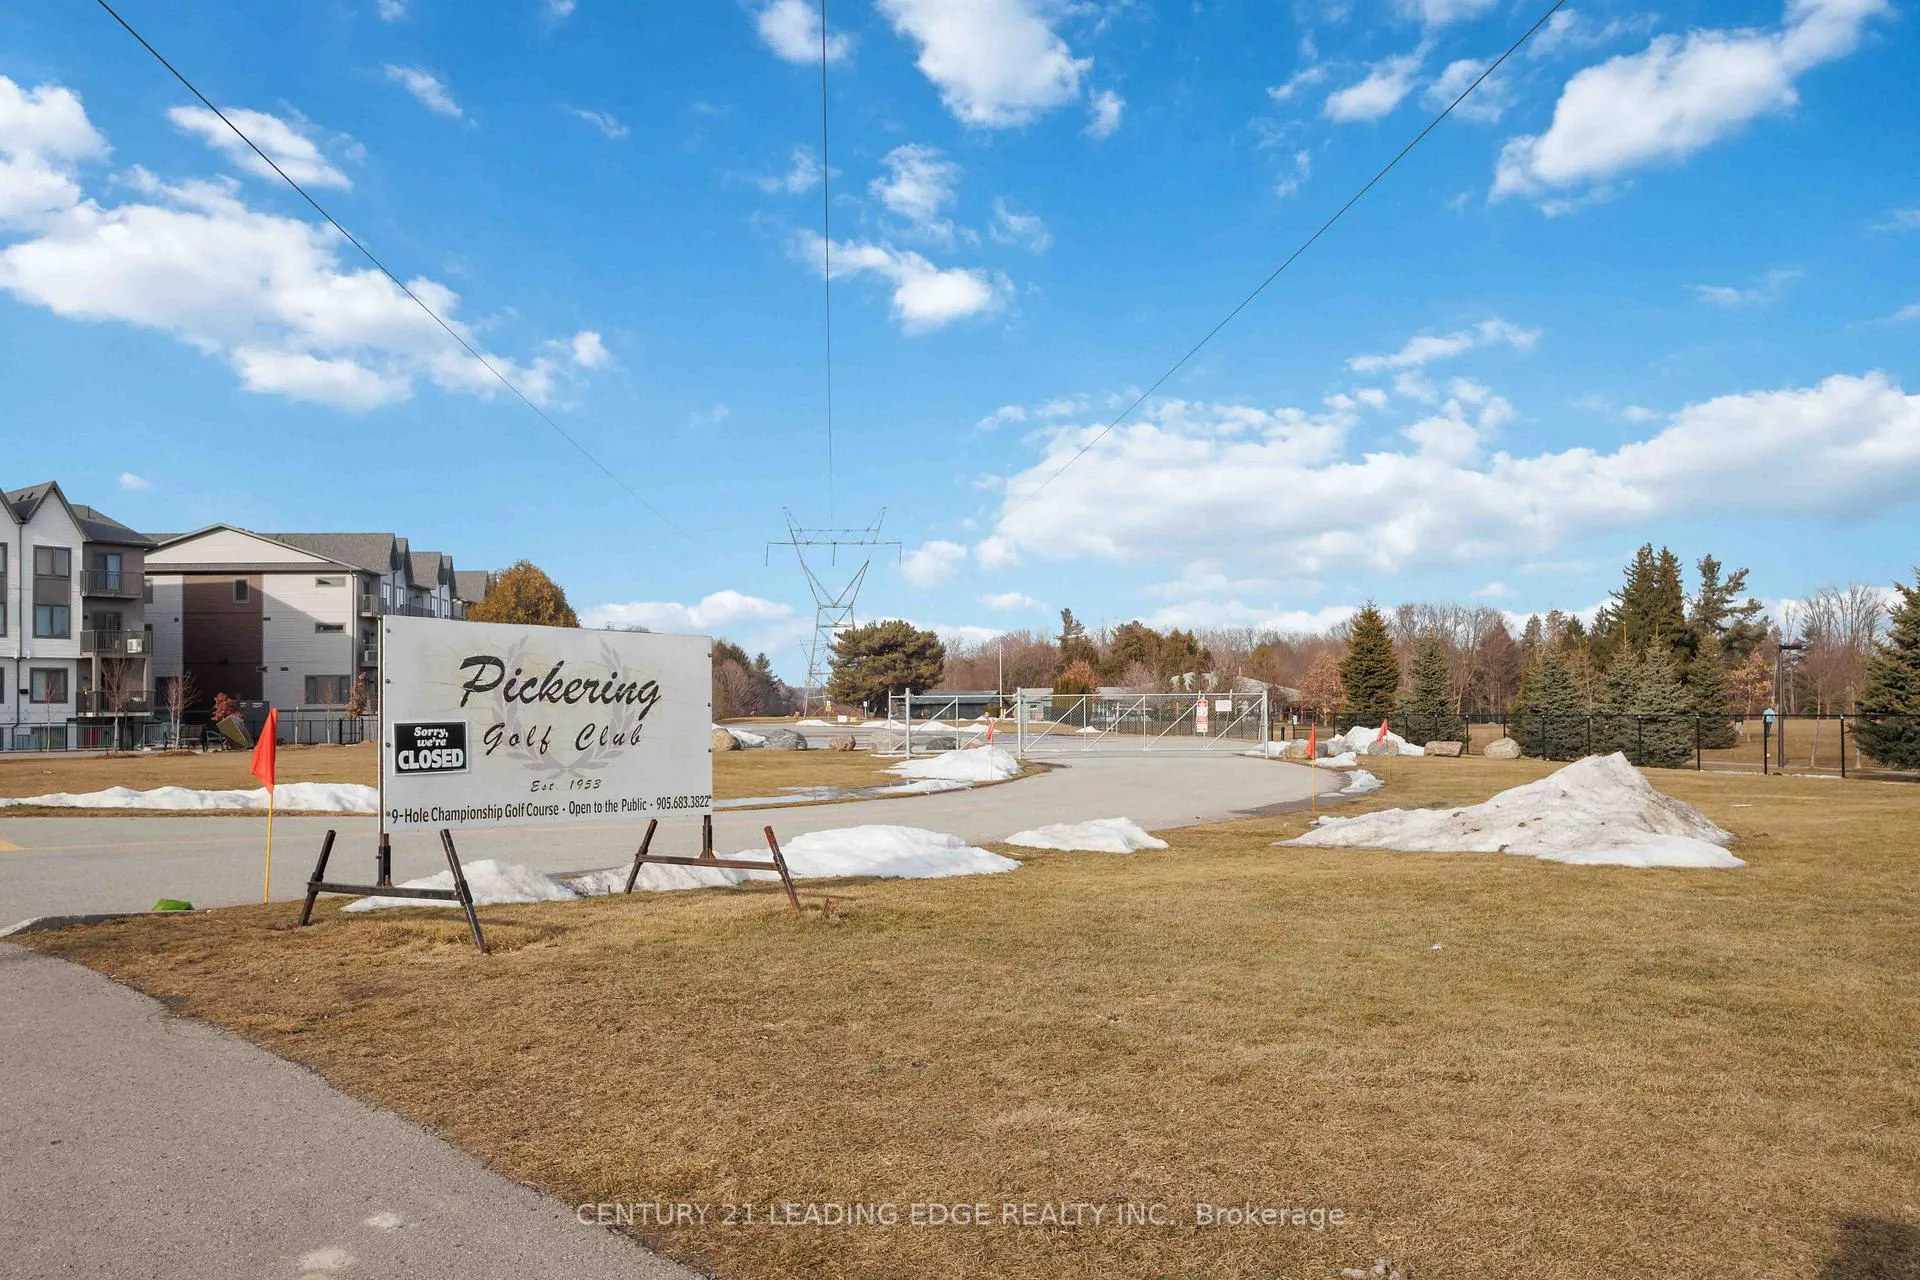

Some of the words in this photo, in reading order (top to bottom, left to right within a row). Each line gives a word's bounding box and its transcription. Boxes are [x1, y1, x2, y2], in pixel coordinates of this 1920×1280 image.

[459, 655, 661, 721] Pickering
[414, 726, 448, 738] Sorry,
[417, 737, 447, 747] we're
[483, 722, 552, 755] Golf
[575, 723, 643, 750] Club
[398, 748, 464, 770] CLOSED
[530, 780, 559, 792] Est.
[569, 779, 601, 790] 1953
[391, 807, 429, 824] 9-Hole
[431, 804, 503, 823] Championship
[504, 803, 525, 818] Golf
[526, 803, 559, 817] Course
[568, 801, 591, 816] Open
[593, 801, 602, 814] to
[604, 800, 618, 813] the
[621, 797, 647, 812] Public
[656, 795, 709, 810] 905.683.3822
